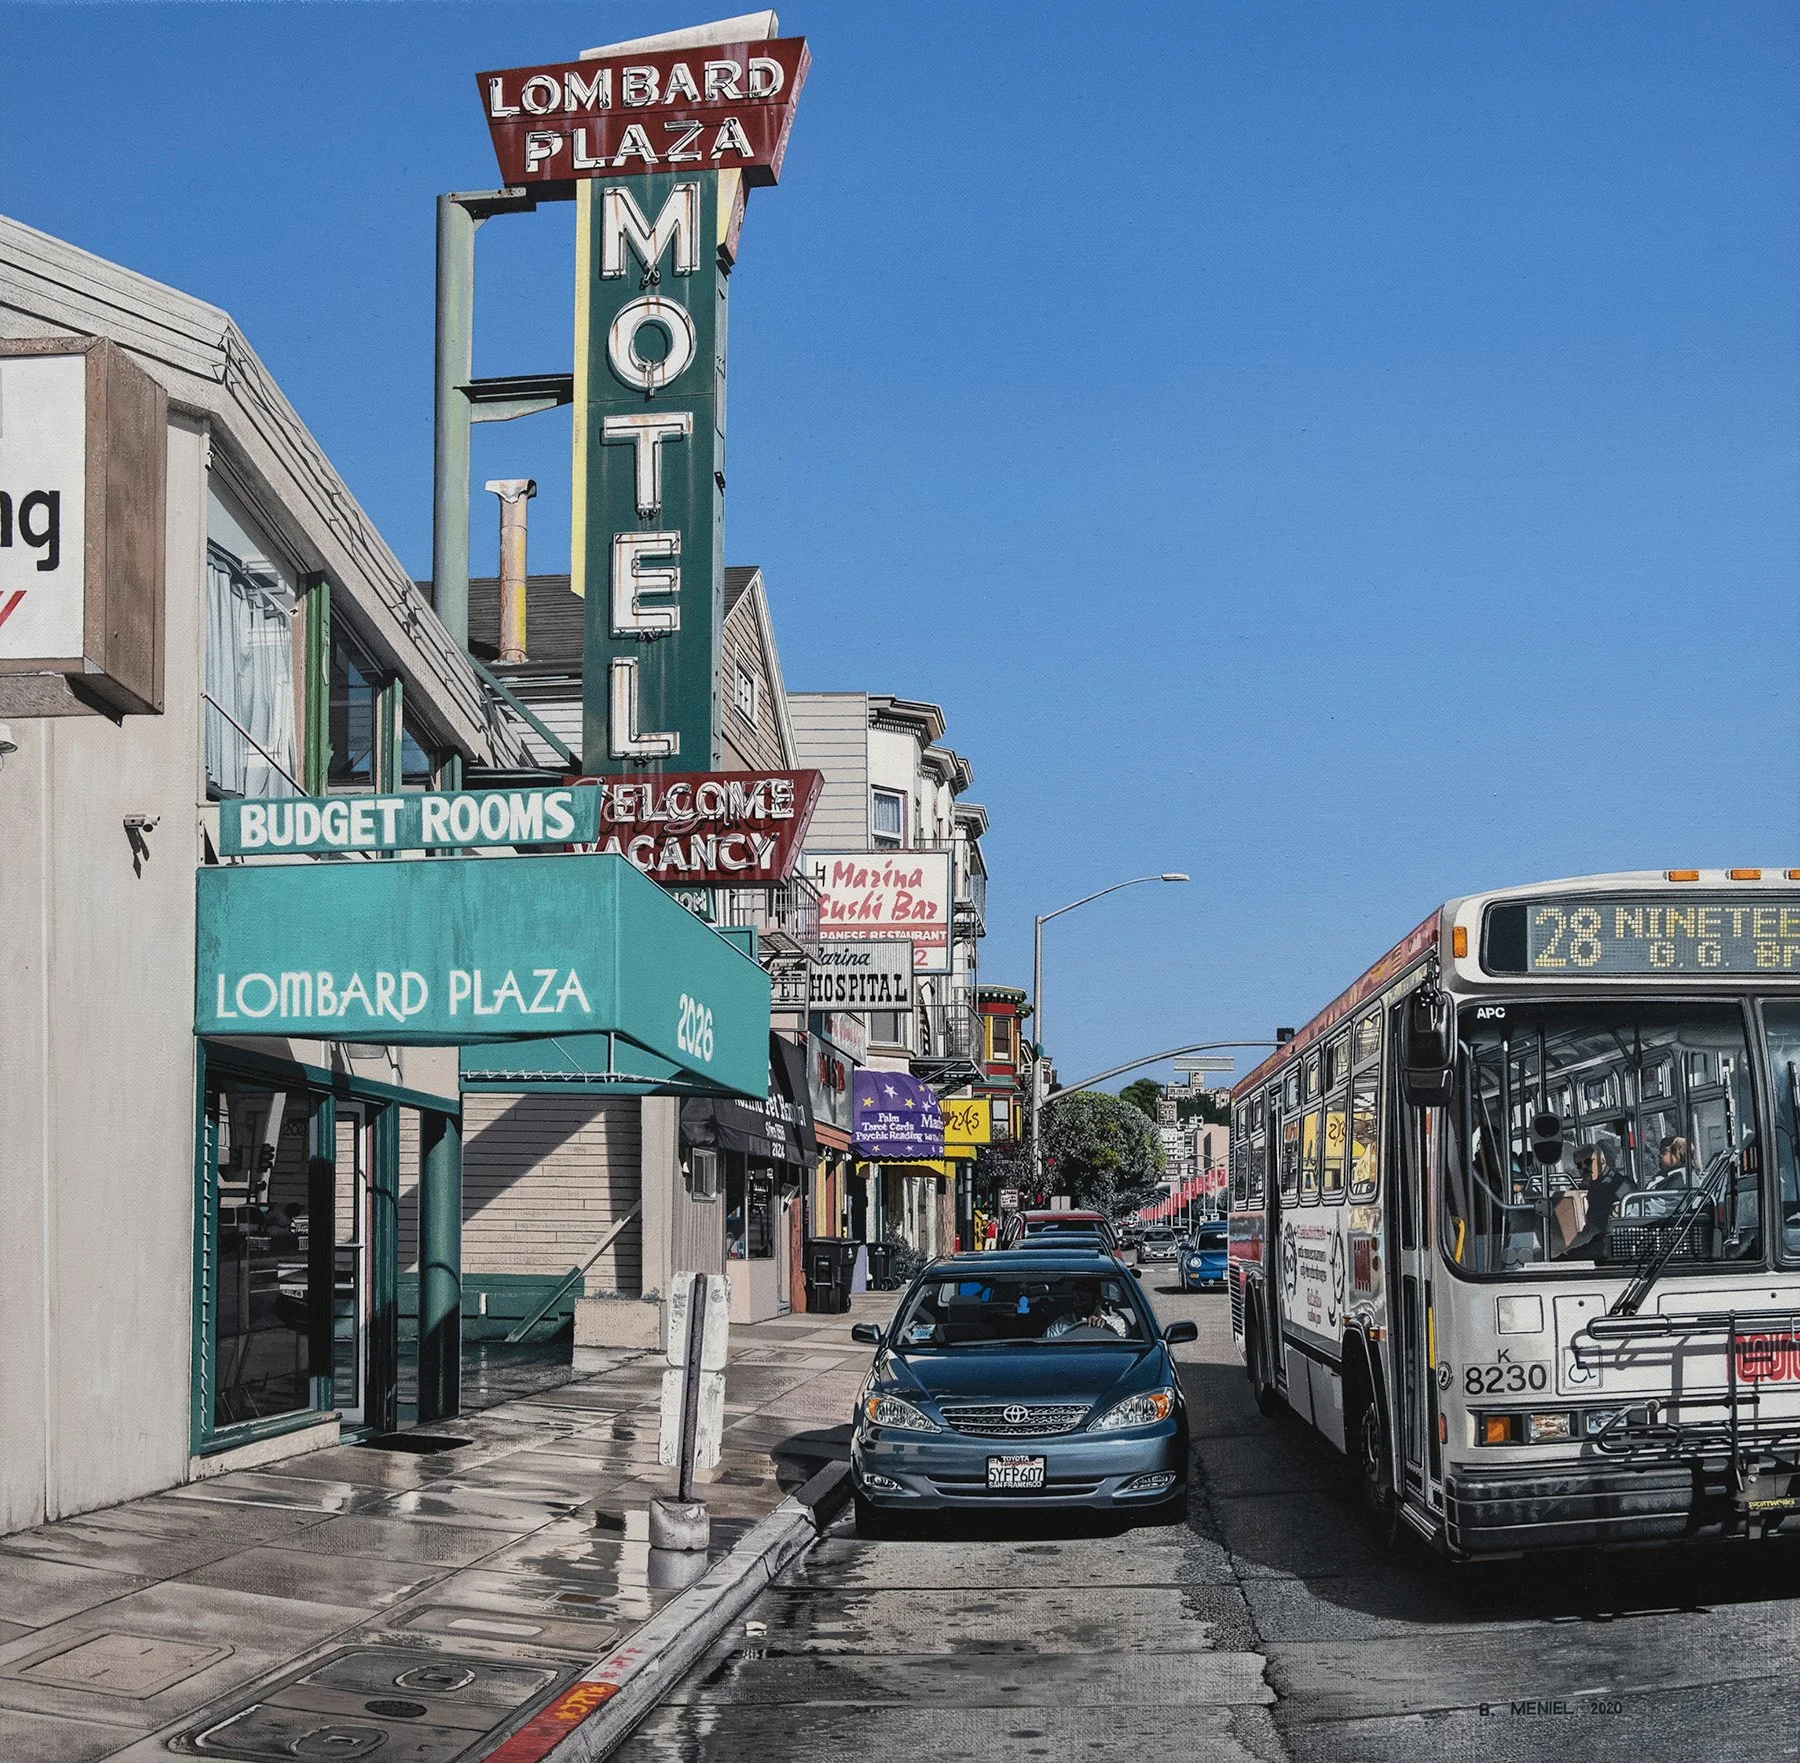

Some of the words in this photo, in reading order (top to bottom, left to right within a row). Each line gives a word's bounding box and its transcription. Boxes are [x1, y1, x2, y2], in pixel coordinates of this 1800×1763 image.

[489, 57, 785, 118] LOMBARD
[525, 116, 755, 172] PLAZA
[601, 181, 700, 754] MOTEL
[599, 779, 794, 823] ELCOME
[240, 798, 404, 848] BUDGET
[421, 792, 575, 842] ROOMS
[832, 858, 924, 888] Marina
[818, 891, 884, 921] Sushi
[891, 890, 938, 921] Bar
[869, 930, 947, 941] RESTAURANT
[1535, 907, 1602, 967] 28
[216, 971, 429, 1023] LOMBARD
[449, 968, 591, 1016] PLAZA
[809, 973, 908, 1002] HOSPITAL
[677, 993, 714, 1062] 2026
[1476, 1006, 1506, 1019] APC
[861, 1122, 888, 1131] Tarot
[878, 1113, 900, 1123] Palm
[855, 1131, 889, 1141] Psychic
[889, 1131, 923, 1143] Reading
[1497, 1348, 1512, 1363] K
[1464, 1363, 1547, 1396] 8230
[989, 1467, 1043, 1482] 5YFP607
[1003, 1480, 1042, 1488] FRANCISCO
[1478, 1702, 1496, 1717] B.
[1510, 1701, 1575, 1716] MENIEL
[1590, 1701, 1623, 1715] 2020
